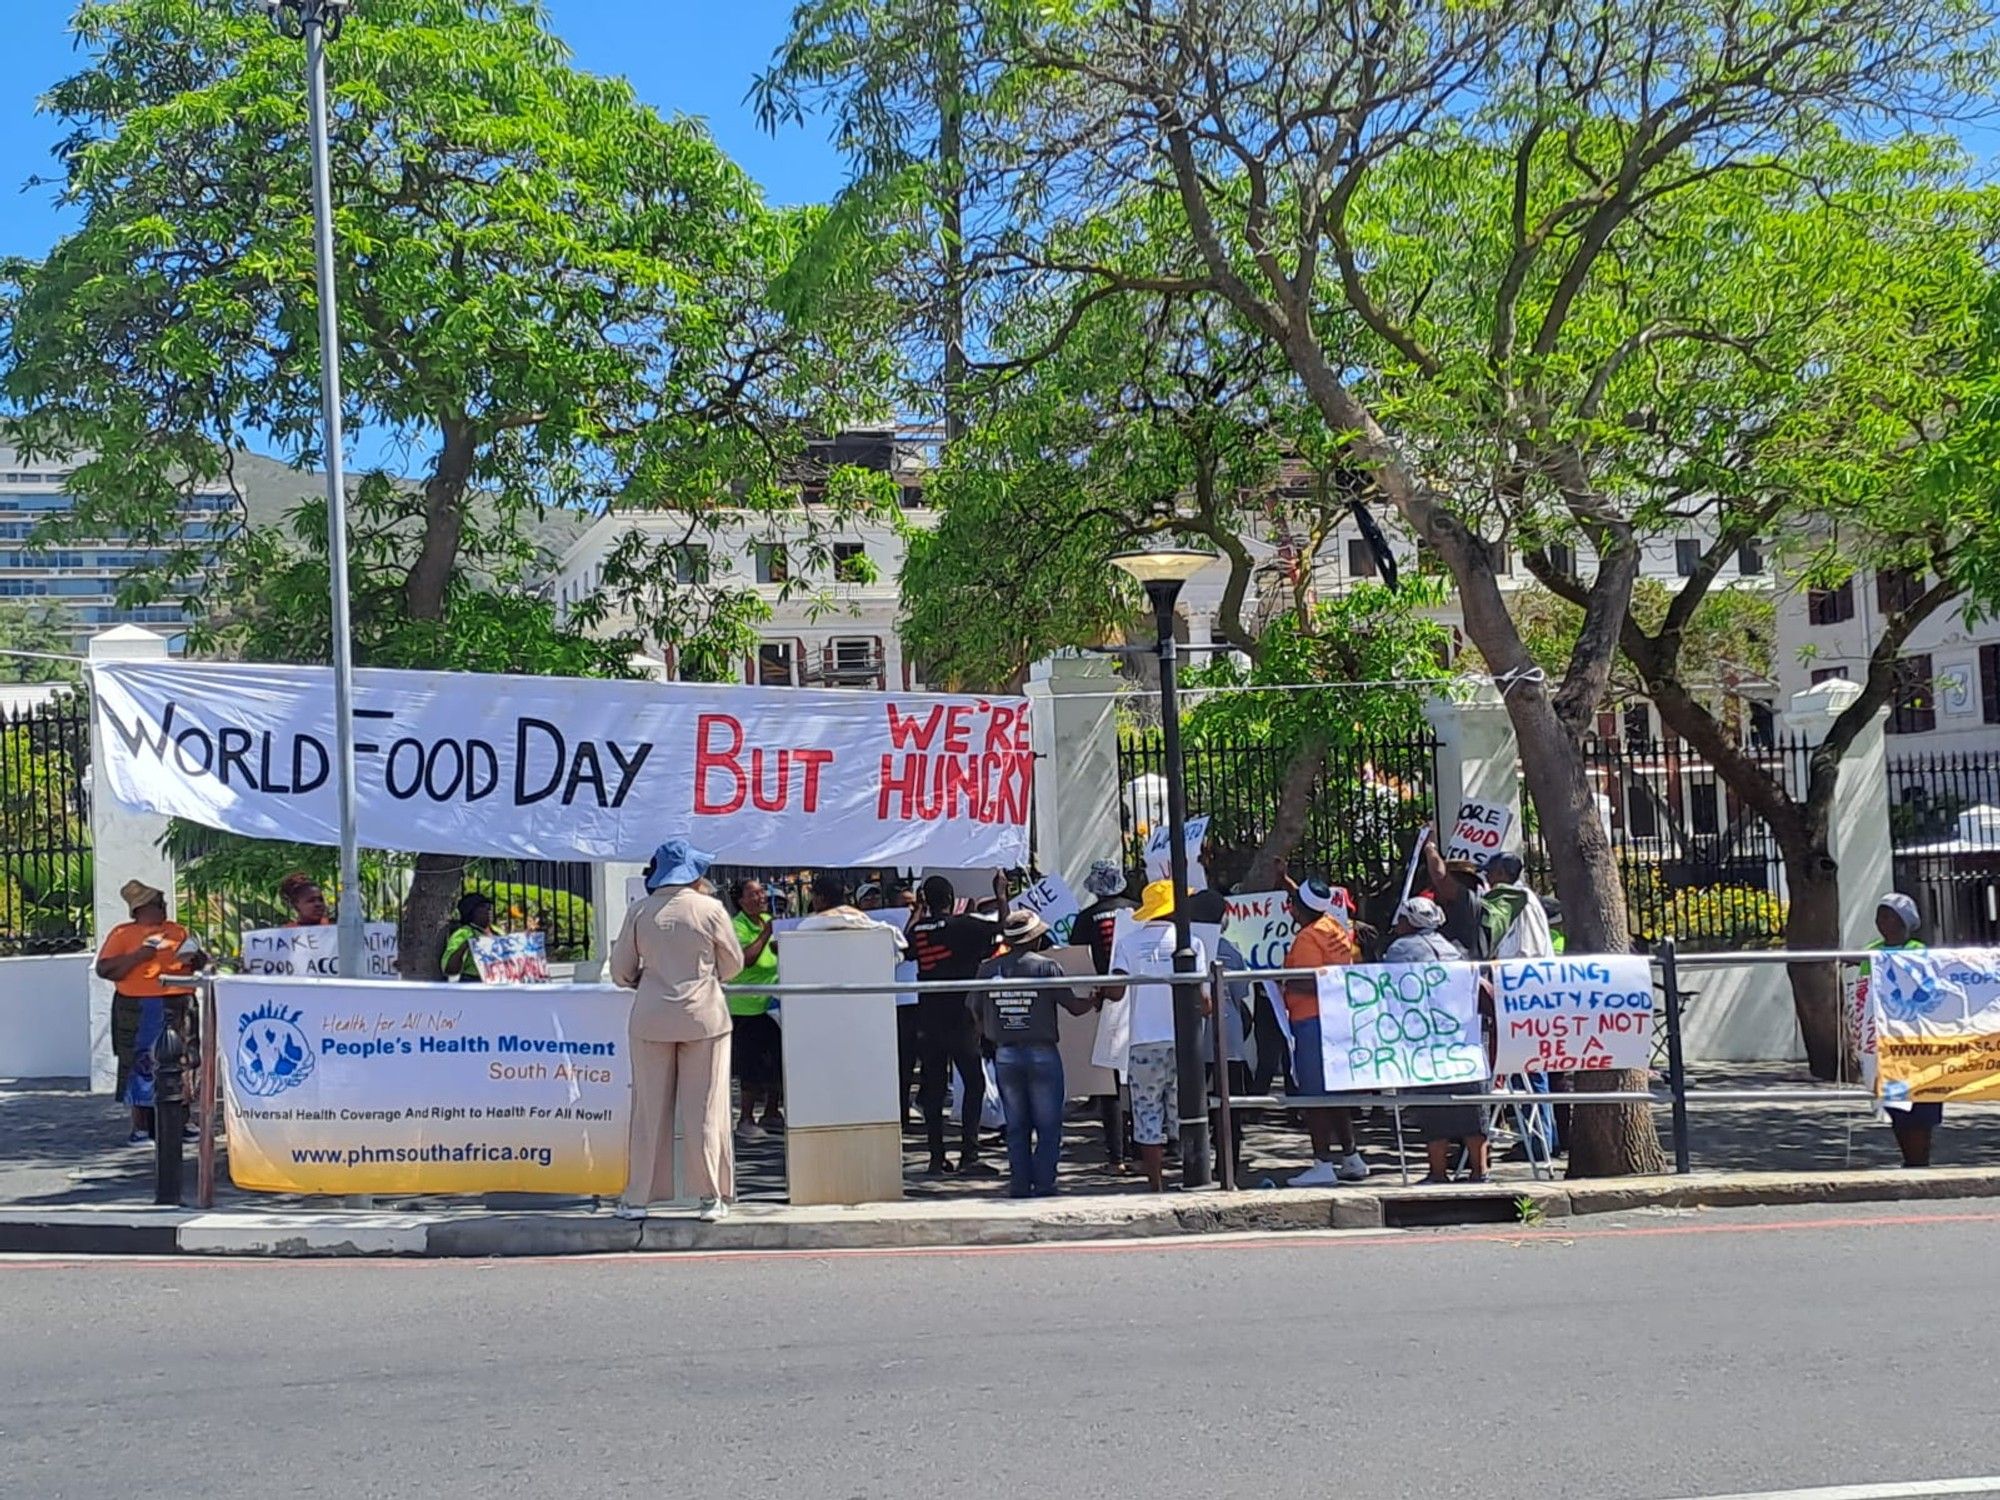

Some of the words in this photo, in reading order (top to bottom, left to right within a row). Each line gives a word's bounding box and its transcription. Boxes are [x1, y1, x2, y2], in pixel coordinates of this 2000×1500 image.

[886, 699, 1030, 753] WE'RE
[99, 693, 329, 794] WORLD
[515, 716, 653, 808] DAY
[693, 714, 833, 815] BUT
[877, 751, 1034, 826] HUNGRY
[1224, 897, 1273, 921] MAKE
[251, 934, 320, 951] MAKE
[250, 958, 295, 976] FOOD
[1502, 962, 1610, 991] EATING
[1345, 966, 1447, 1008] DROP
[1504, 991, 1582, 1013] HEALTY
[1588, 991, 1653, 1010] FOOD
[322, 1012, 367, 1033] Health
[373, 1012, 395, 1041] for
[402, 1011, 422, 1030] All
[1351, 1007, 1460, 1045] FOOD
[1511, 1015, 1589, 1039] MUST
[1599, 1012, 1650, 1034] NOT
[321, 1037, 412, 1059] People's
[420, 1035, 489, 1053] Health
[498, 1035, 616, 1056] Movement
[1539, 1040, 1567, 1059] BE
[1583, 1035, 1604, 1055] A
[489, 1062, 547, 1080] South
[554, 1063, 612, 1083] Africa
[1348, 1042, 1477, 1082] PRICES
[1524, 1055, 1614, 1073] CHOICE
[235, 1107, 293, 1121] Universal
[296, 1108, 336, 1120] Health
[340, 1108, 401, 1122] Coverage
[405, 1108, 429, 1119] And
[431, 1107, 465, 1121] Right
[469, 1107, 482, 1118] to
[486, 1106, 526, 1118] Health
[529, 1107, 551, 1119] For
[555, 1108, 572, 1119] All
[292, 1143, 552, 1168] www.phmsouthafrica.org
